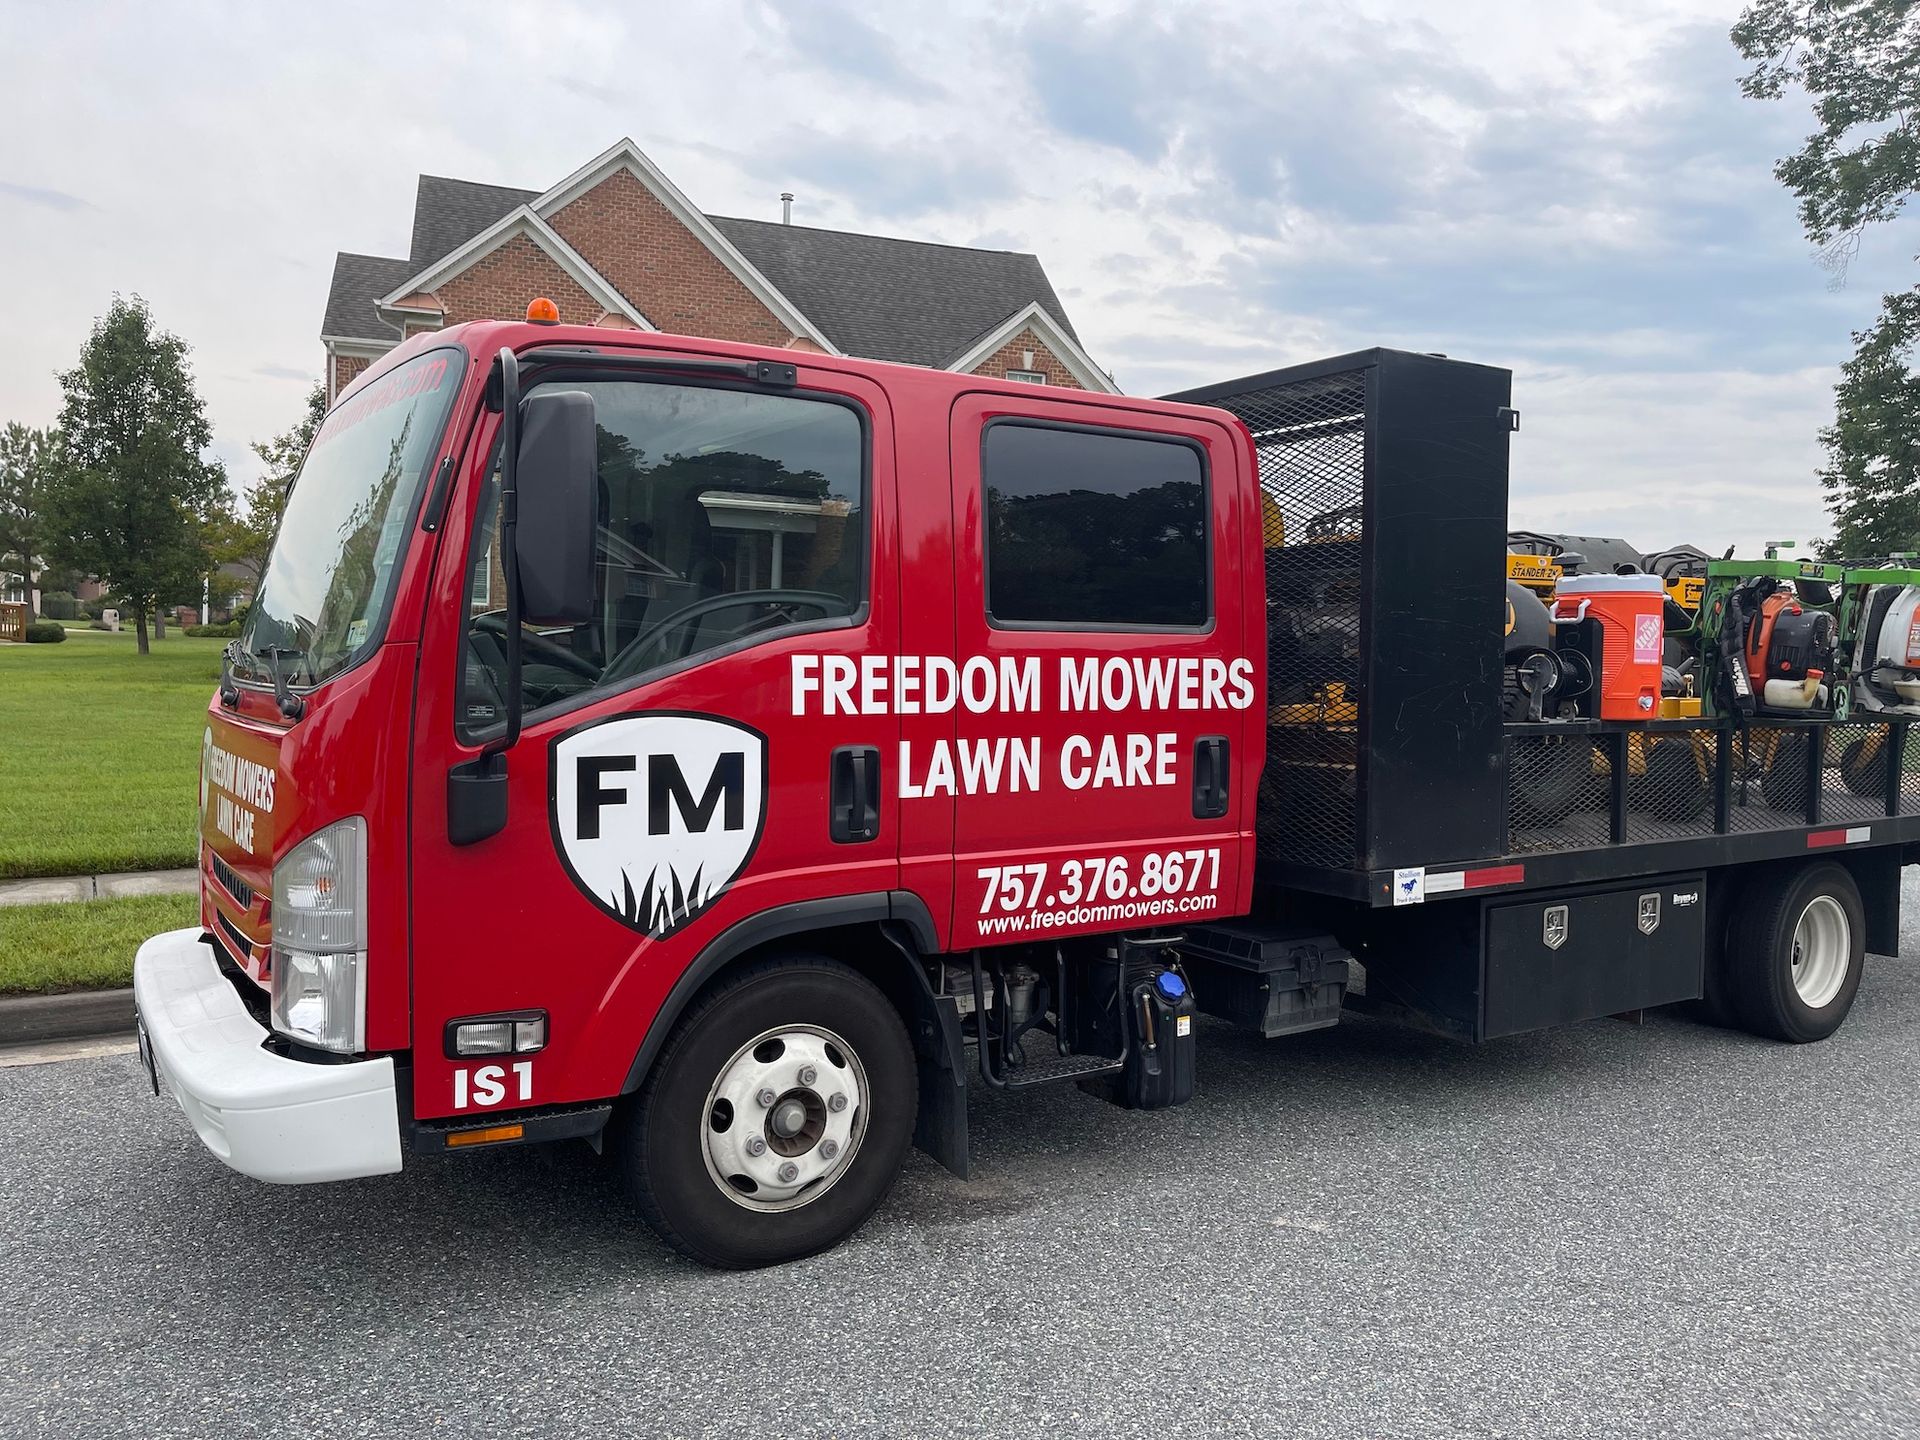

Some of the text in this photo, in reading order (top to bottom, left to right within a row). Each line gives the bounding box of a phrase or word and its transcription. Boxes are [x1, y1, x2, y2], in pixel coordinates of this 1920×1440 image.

[1511, 567, 1546, 578] STANDER
[1636, 616, 1660, 648] HOME
[791, 654, 1255, 716] FREEDOM MOWERS
[235, 756, 275, 813] MOWERS
[898, 732, 1178, 799] LAWN CARE
[576, 752, 745, 840] FM
[234, 804, 255, 855] CARE
[976, 848, 1221, 914] 757.376.8671
[977, 893, 1217, 935] www.freedommowers.com
